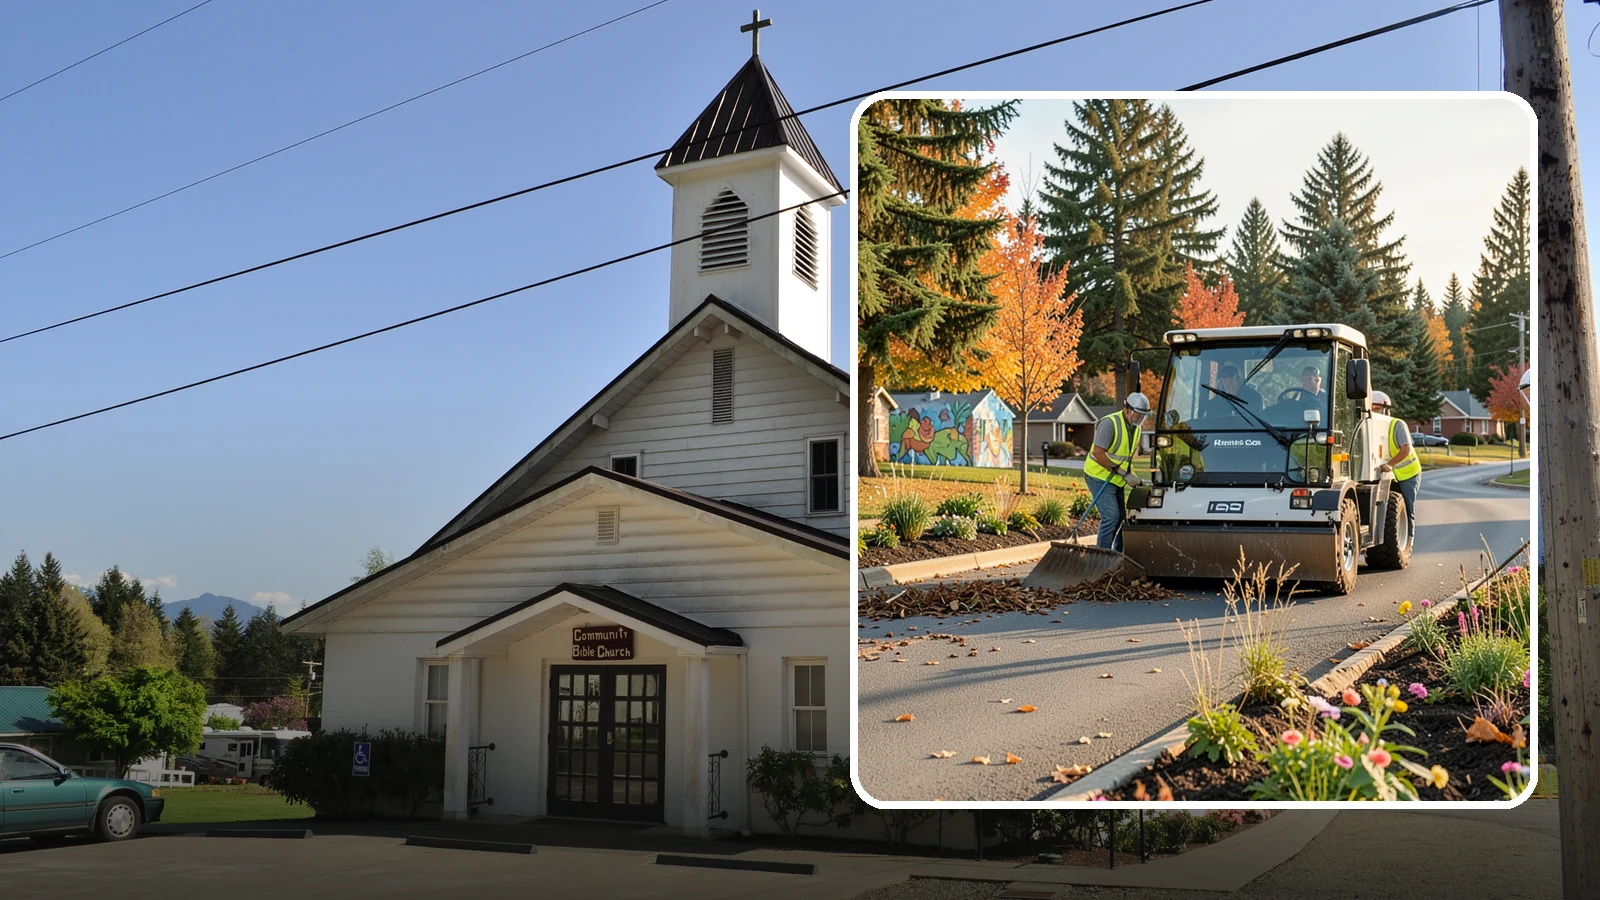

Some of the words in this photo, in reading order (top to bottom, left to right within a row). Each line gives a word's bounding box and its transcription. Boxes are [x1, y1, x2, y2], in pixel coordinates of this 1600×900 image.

[574, 627, 628, 641] Community
[572, 644, 595, 657] Bible
[597, 645, 631, 658] Church
